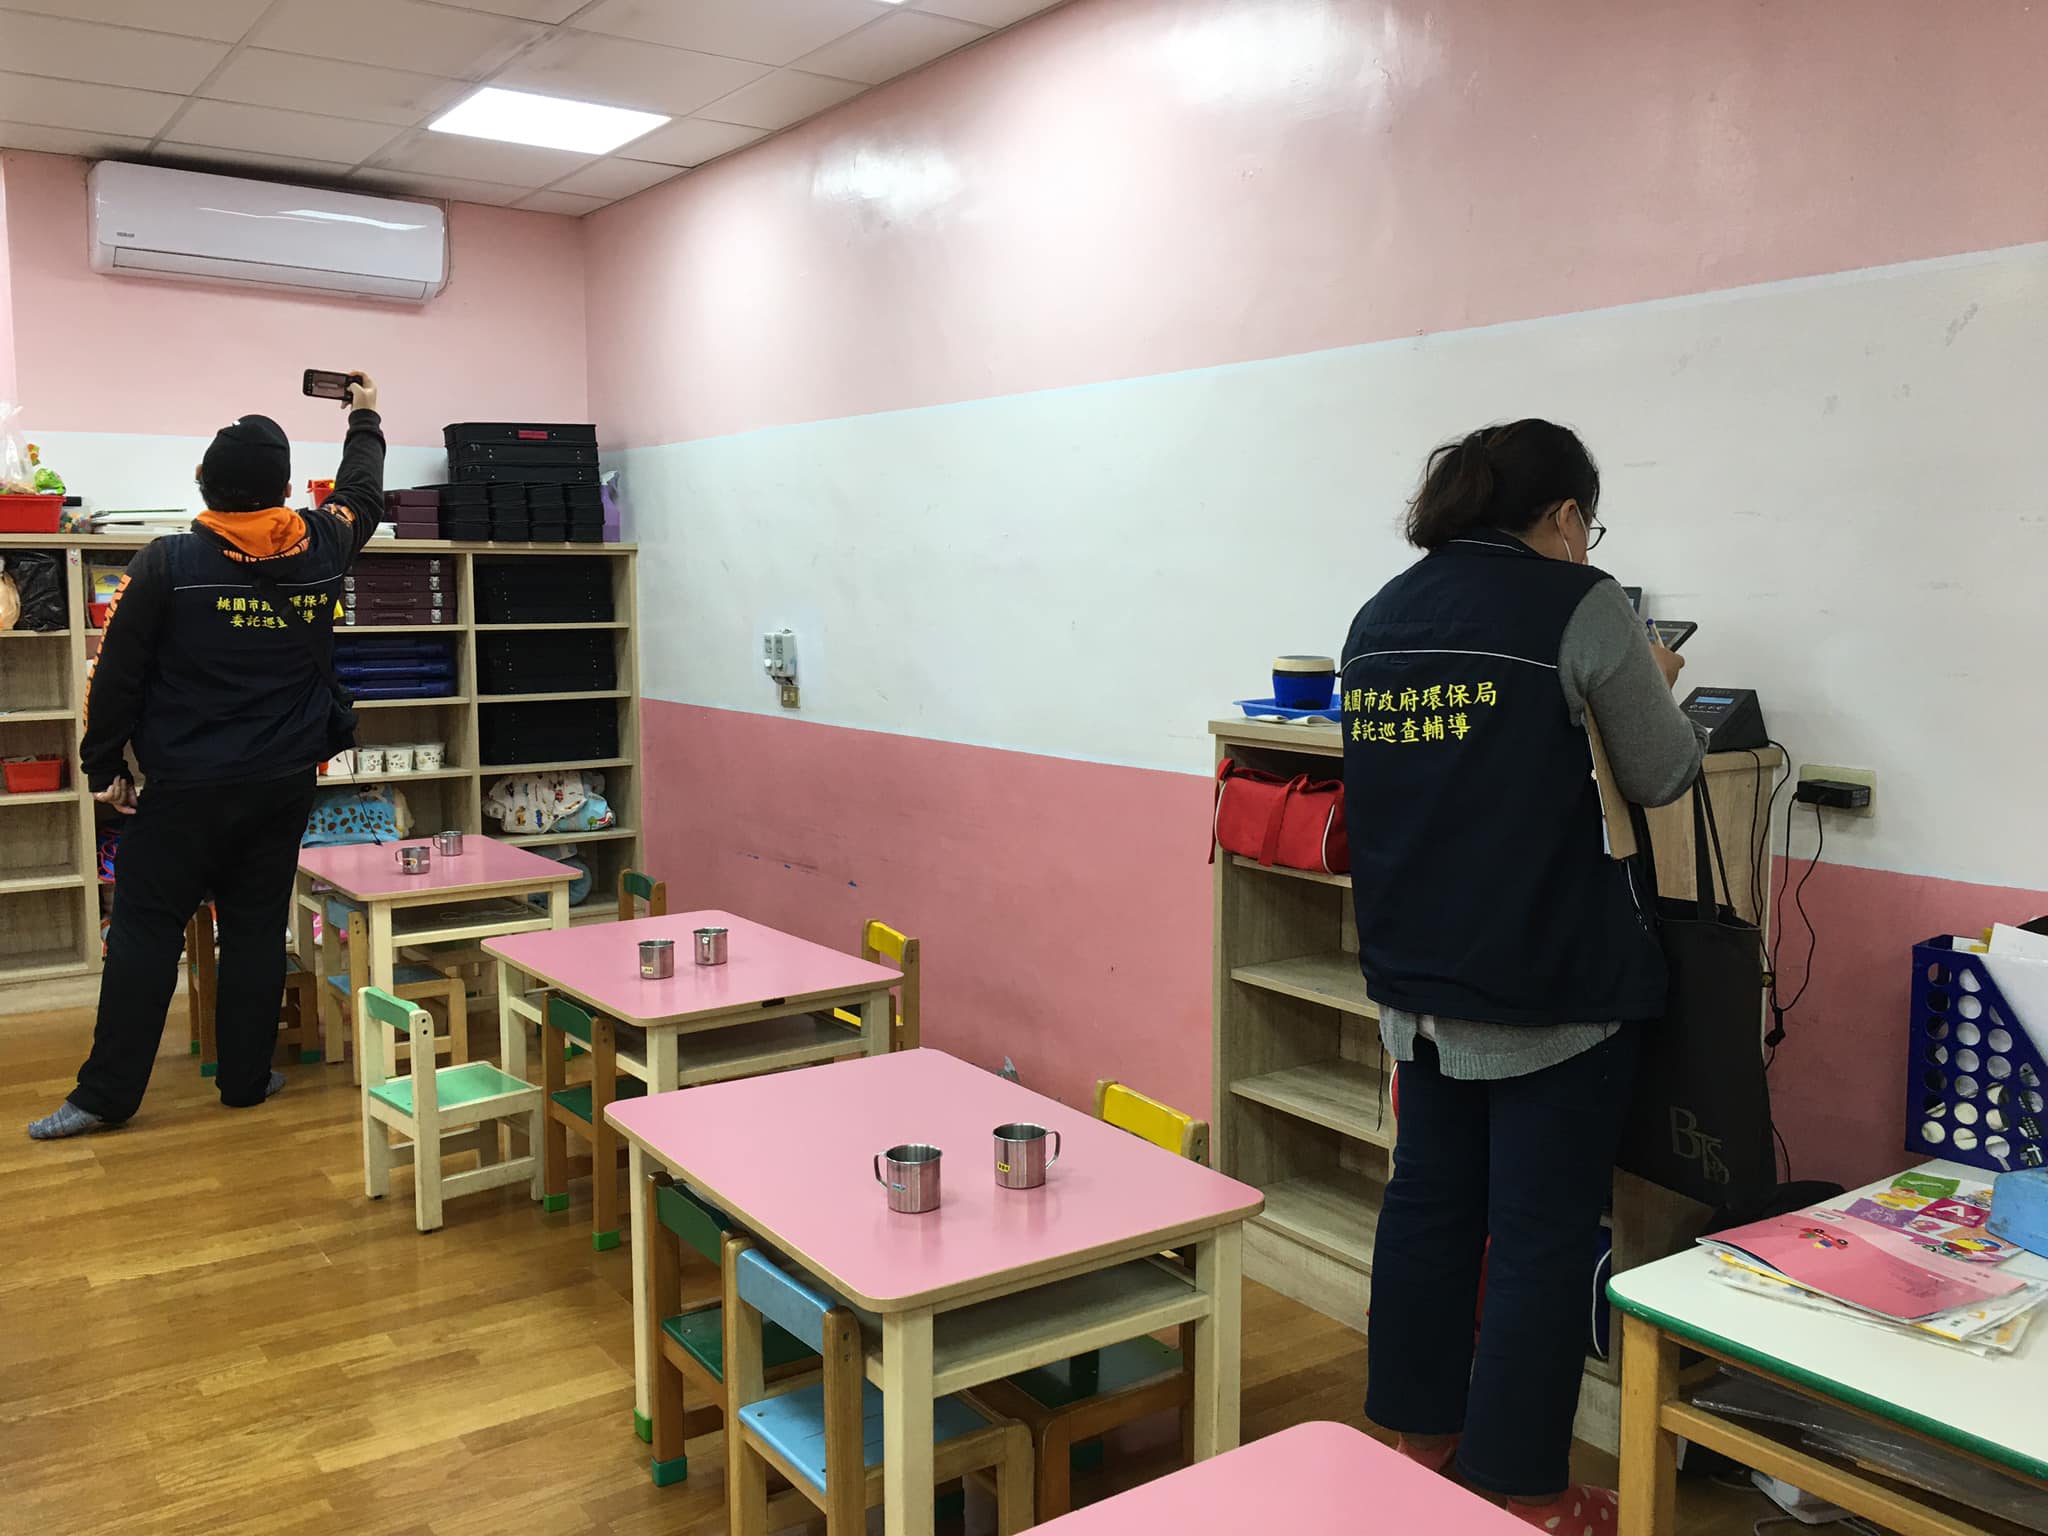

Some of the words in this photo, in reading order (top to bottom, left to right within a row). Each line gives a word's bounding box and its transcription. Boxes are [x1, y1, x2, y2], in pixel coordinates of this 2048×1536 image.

[1351, 711, 1471, 744] 委託巡查輔導
